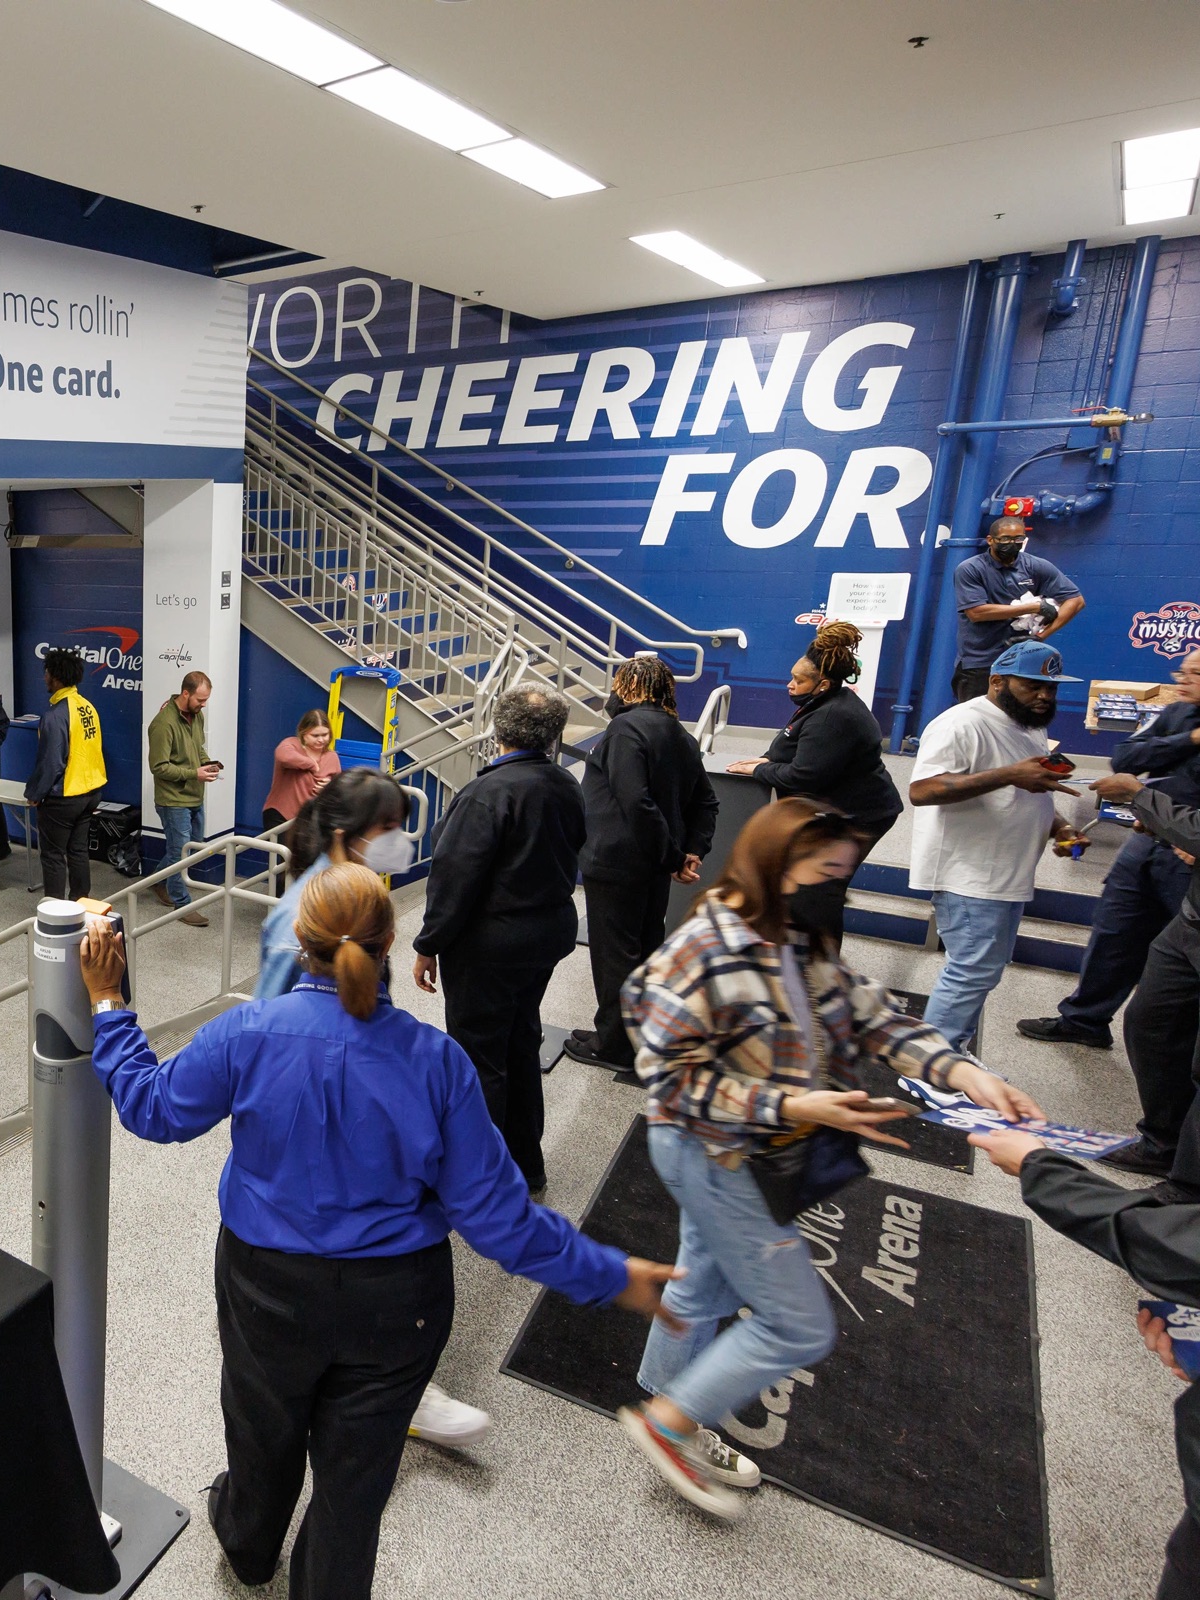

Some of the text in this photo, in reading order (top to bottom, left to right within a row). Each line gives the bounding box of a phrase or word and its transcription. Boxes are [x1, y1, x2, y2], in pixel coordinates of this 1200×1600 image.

[246, 277, 511, 372] ORTH
[52, 359, 121, 399] card.
[314, 321, 916, 455] CHEERING
[639, 446, 952, 550] FOR.
[155, 593, 197, 610] Let’s go
[860, 1194, 924, 1308] Arena
